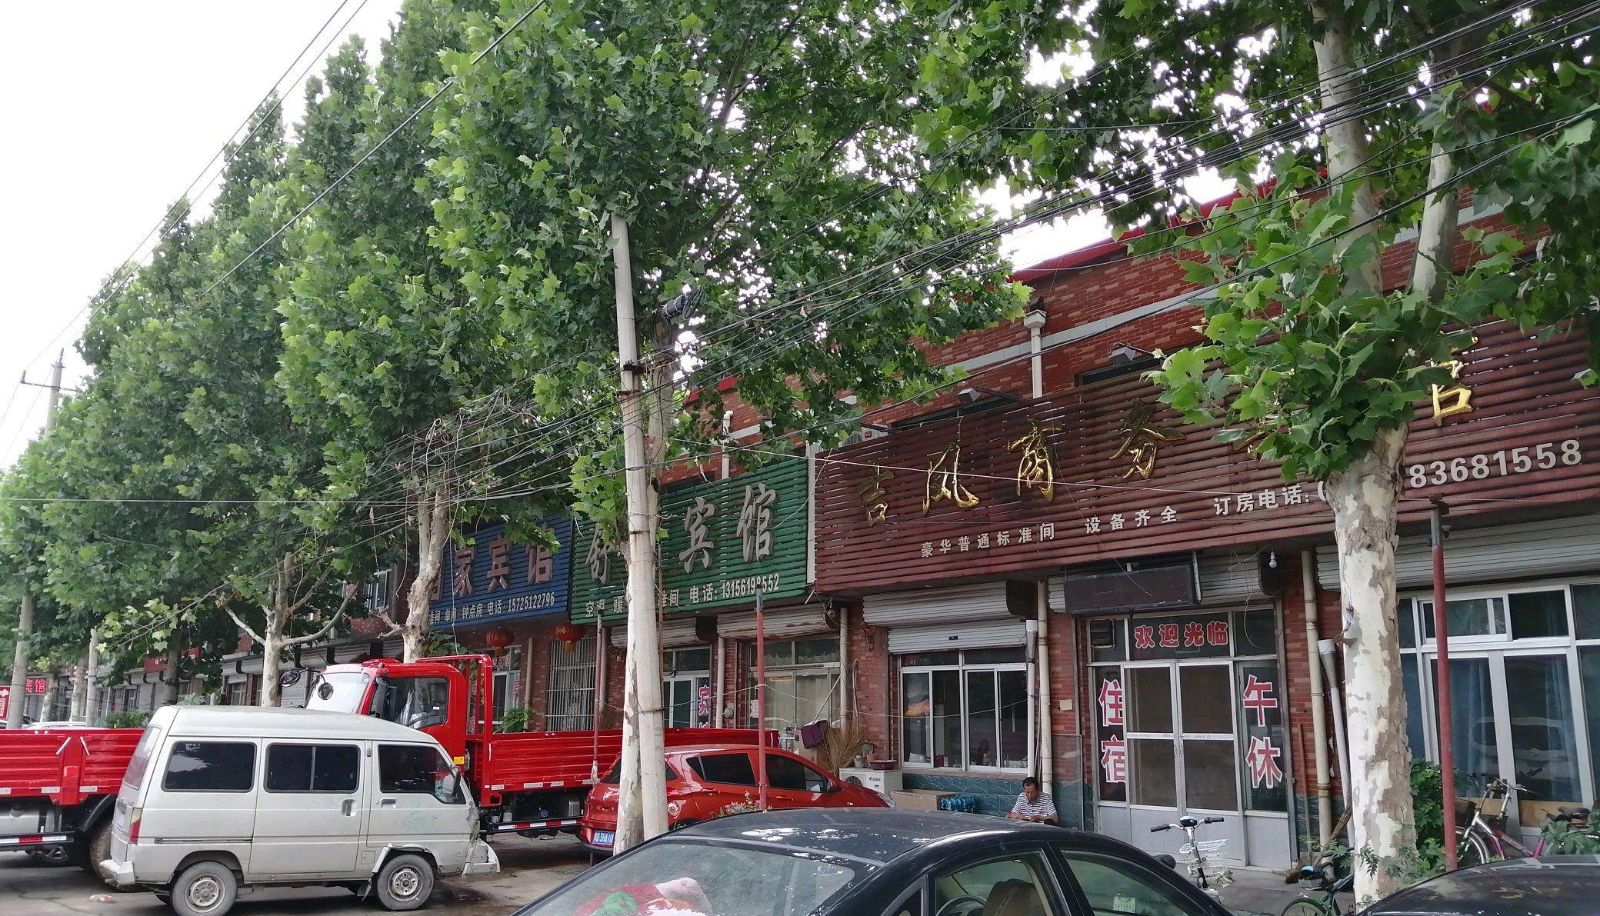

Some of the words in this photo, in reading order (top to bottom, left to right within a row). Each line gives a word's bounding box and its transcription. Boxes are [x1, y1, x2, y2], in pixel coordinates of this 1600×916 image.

[921, 523, 1056, 558] 豪华普通标准间
[1086, 505, 1178, 535] 设备齐全
[1409, 439, 1583, 489] 83681558
[1134, 621, 1229, 649] 欢迎光临
[1098, 678, 1127, 783] 住宿
[1242, 674, 1283, 789] 午休
